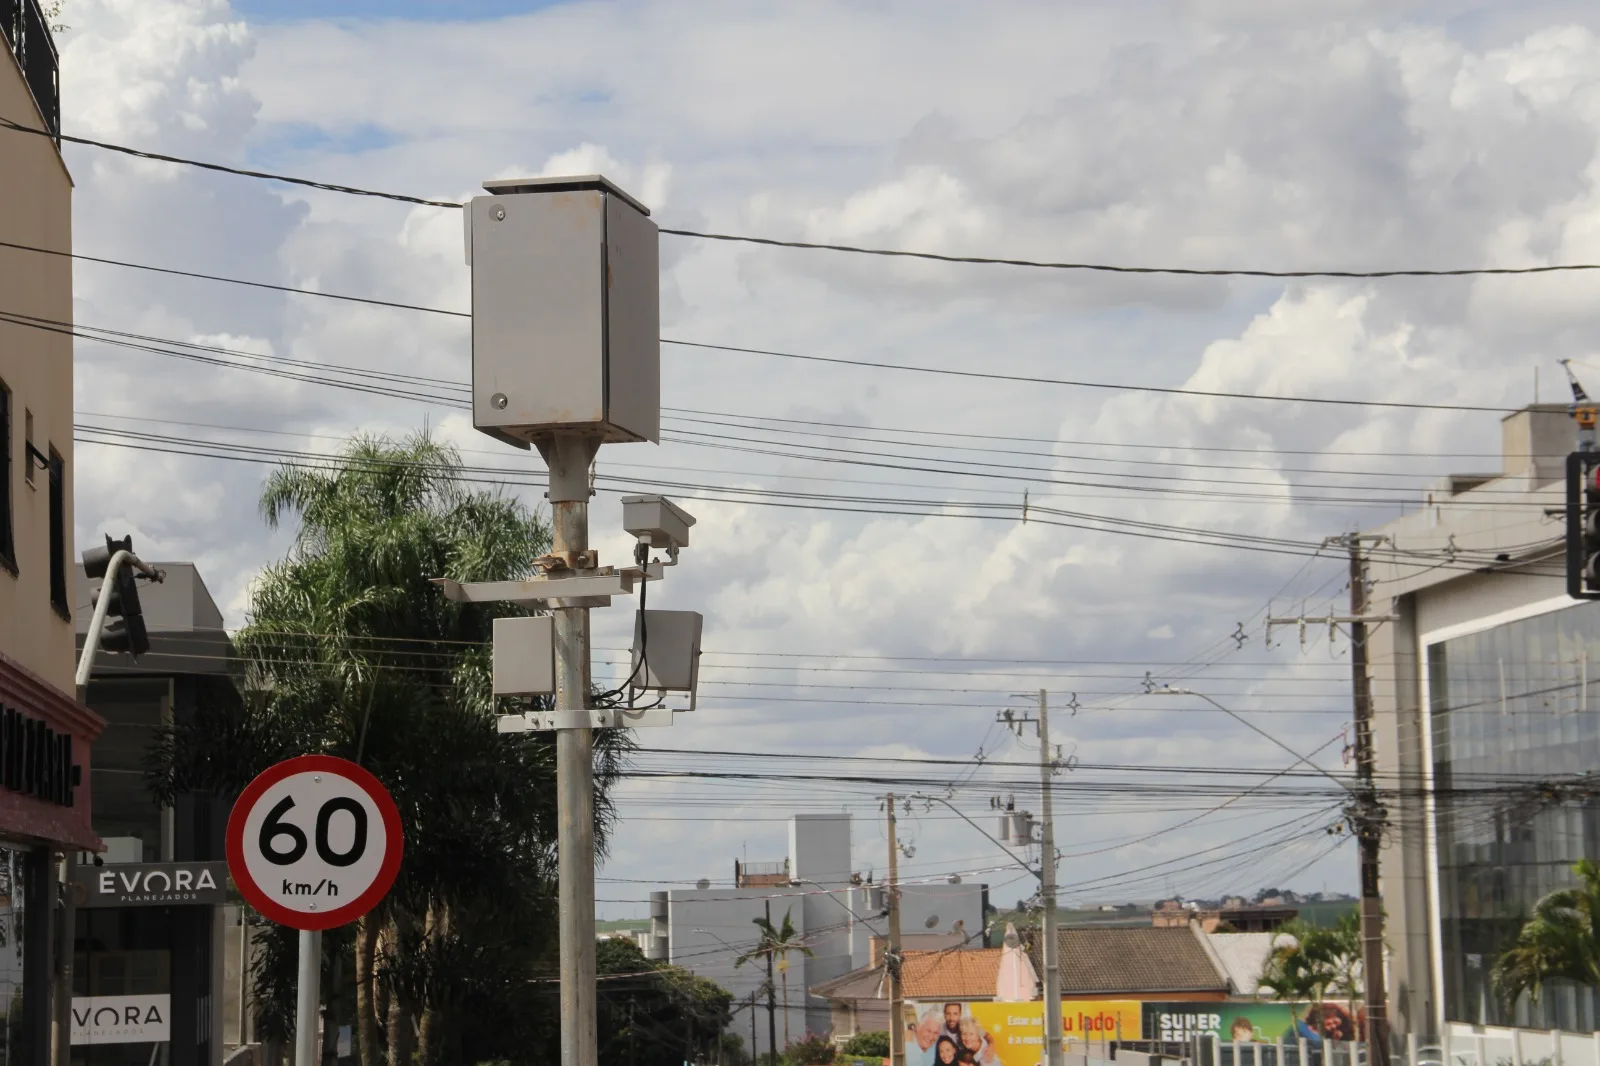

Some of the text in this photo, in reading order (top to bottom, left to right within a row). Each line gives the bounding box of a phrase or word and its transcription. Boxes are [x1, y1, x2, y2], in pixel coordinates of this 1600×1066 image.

[259, 795, 368, 867] 60
[282, 879, 338, 896] km/h
[121, 893, 197, 901] PLANEJADOS
[72, 1005, 163, 1027] VORA
[1079, 1012, 1114, 1031] lado
[1160, 1013, 1221, 1029] SUPER
[73, 1028, 144, 1037] PLANEJADOS
